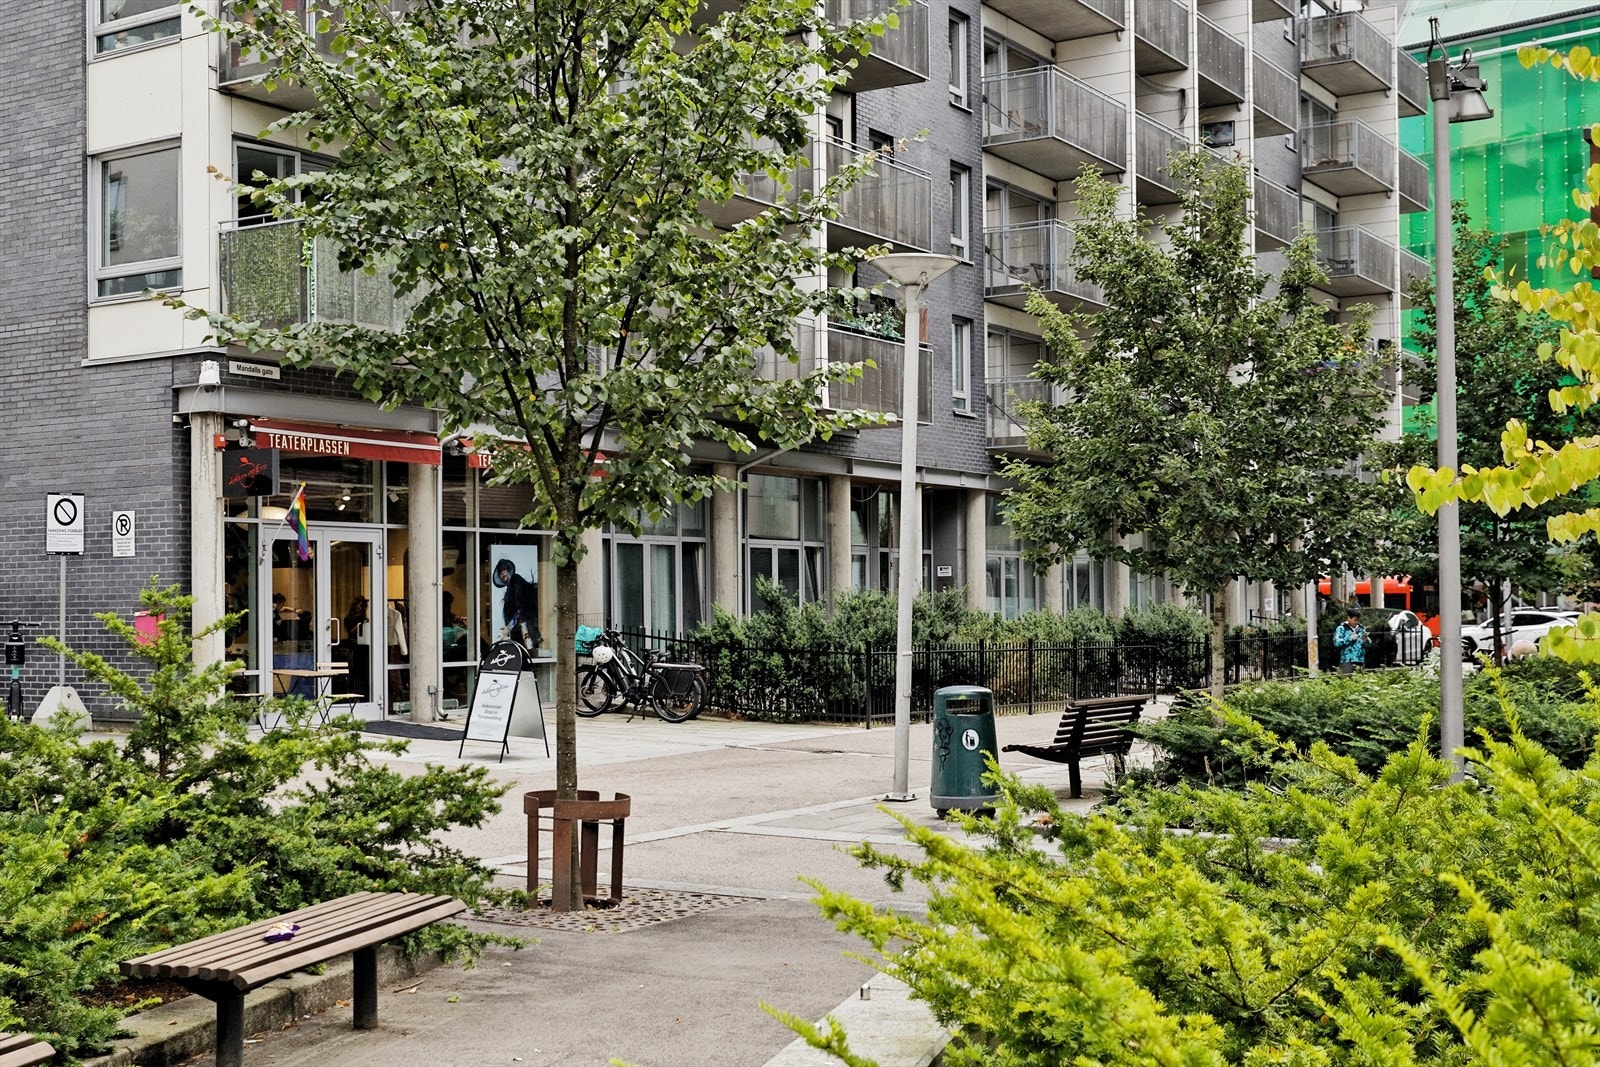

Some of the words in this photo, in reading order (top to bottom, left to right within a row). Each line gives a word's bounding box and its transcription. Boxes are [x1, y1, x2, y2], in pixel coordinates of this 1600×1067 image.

[236, 364, 261, 374] Mandalls
[262, 368, 274, 376] gate
[269, 433, 350, 455] TEATERPLASSEN
